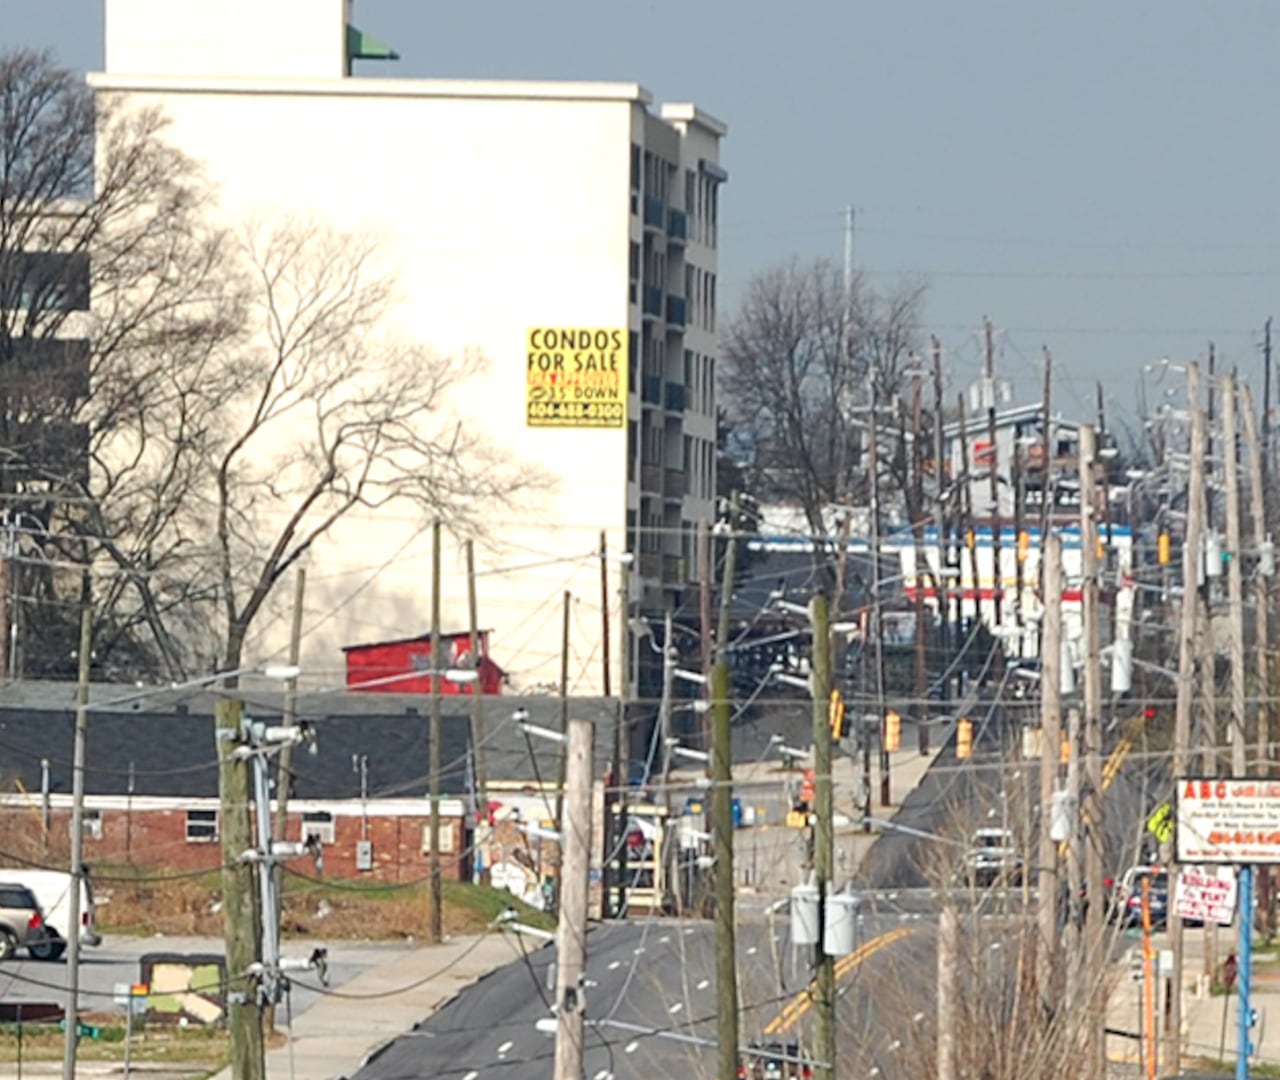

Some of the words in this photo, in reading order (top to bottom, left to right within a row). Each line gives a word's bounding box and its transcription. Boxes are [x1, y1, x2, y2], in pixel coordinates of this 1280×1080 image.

[530, 329, 622, 351] CONDOS
[528, 352, 564, 372] FOR
[574, 352, 618, 372] SALE
